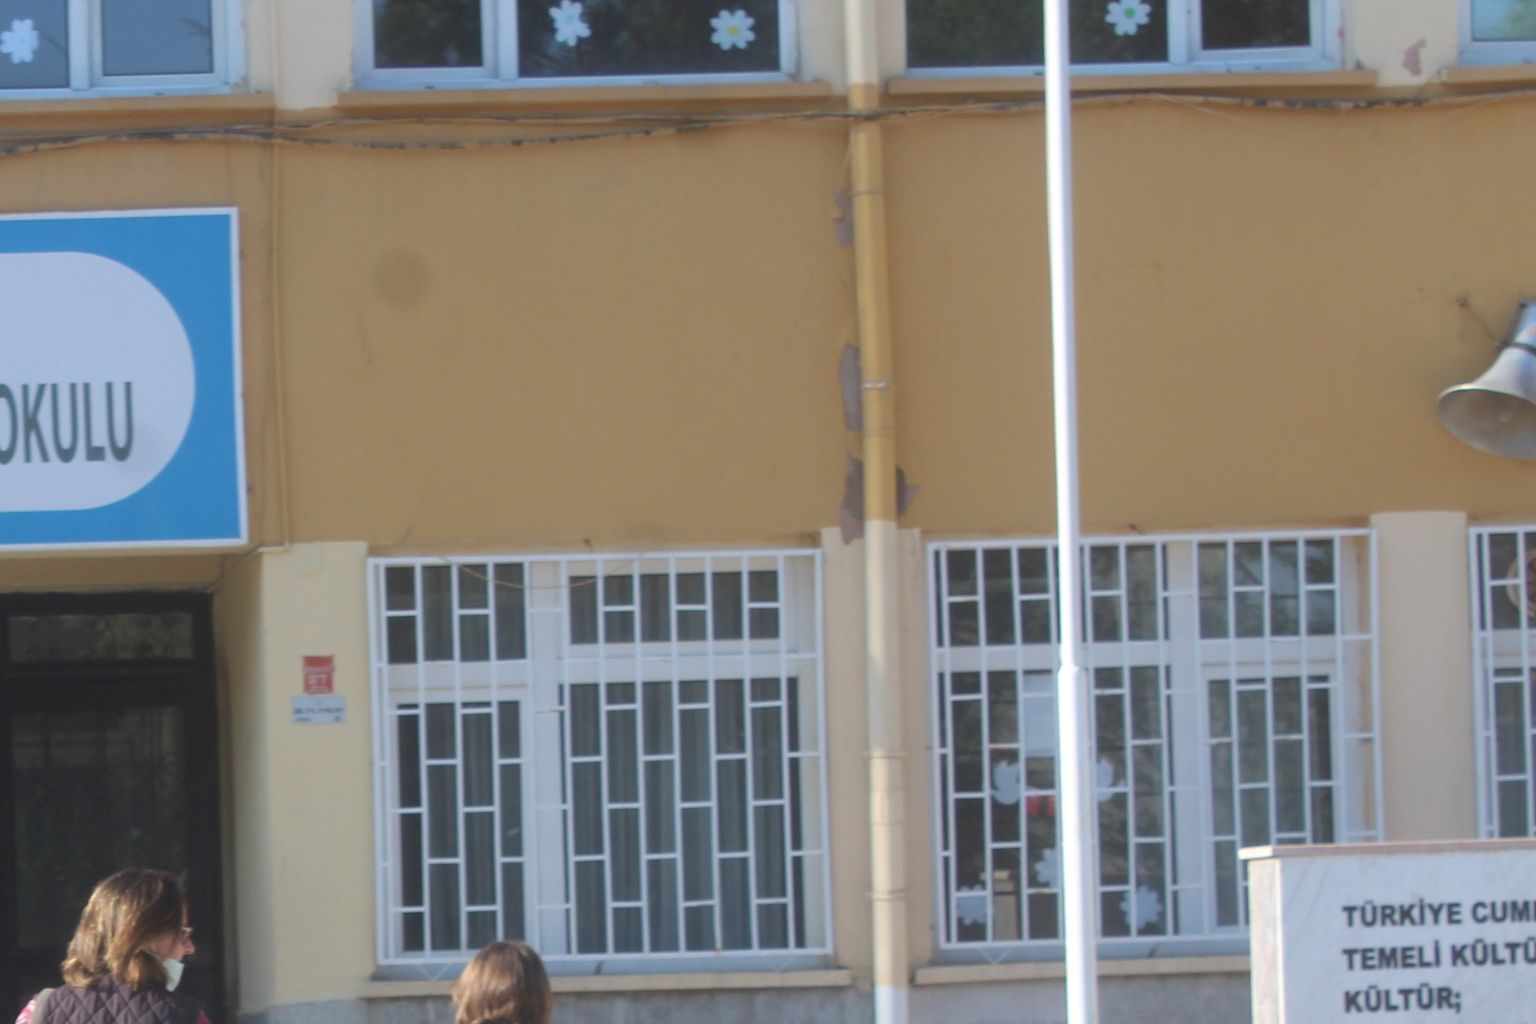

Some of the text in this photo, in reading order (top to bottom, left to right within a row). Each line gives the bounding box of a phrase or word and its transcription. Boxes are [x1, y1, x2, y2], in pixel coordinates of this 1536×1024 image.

[1342, 898, 1536, 928] TÜRKİYE CUM
[1342, 940, 1442, 971] TEMELİ
[1344, 983, 1462, 1015] KÜLTÜR;
